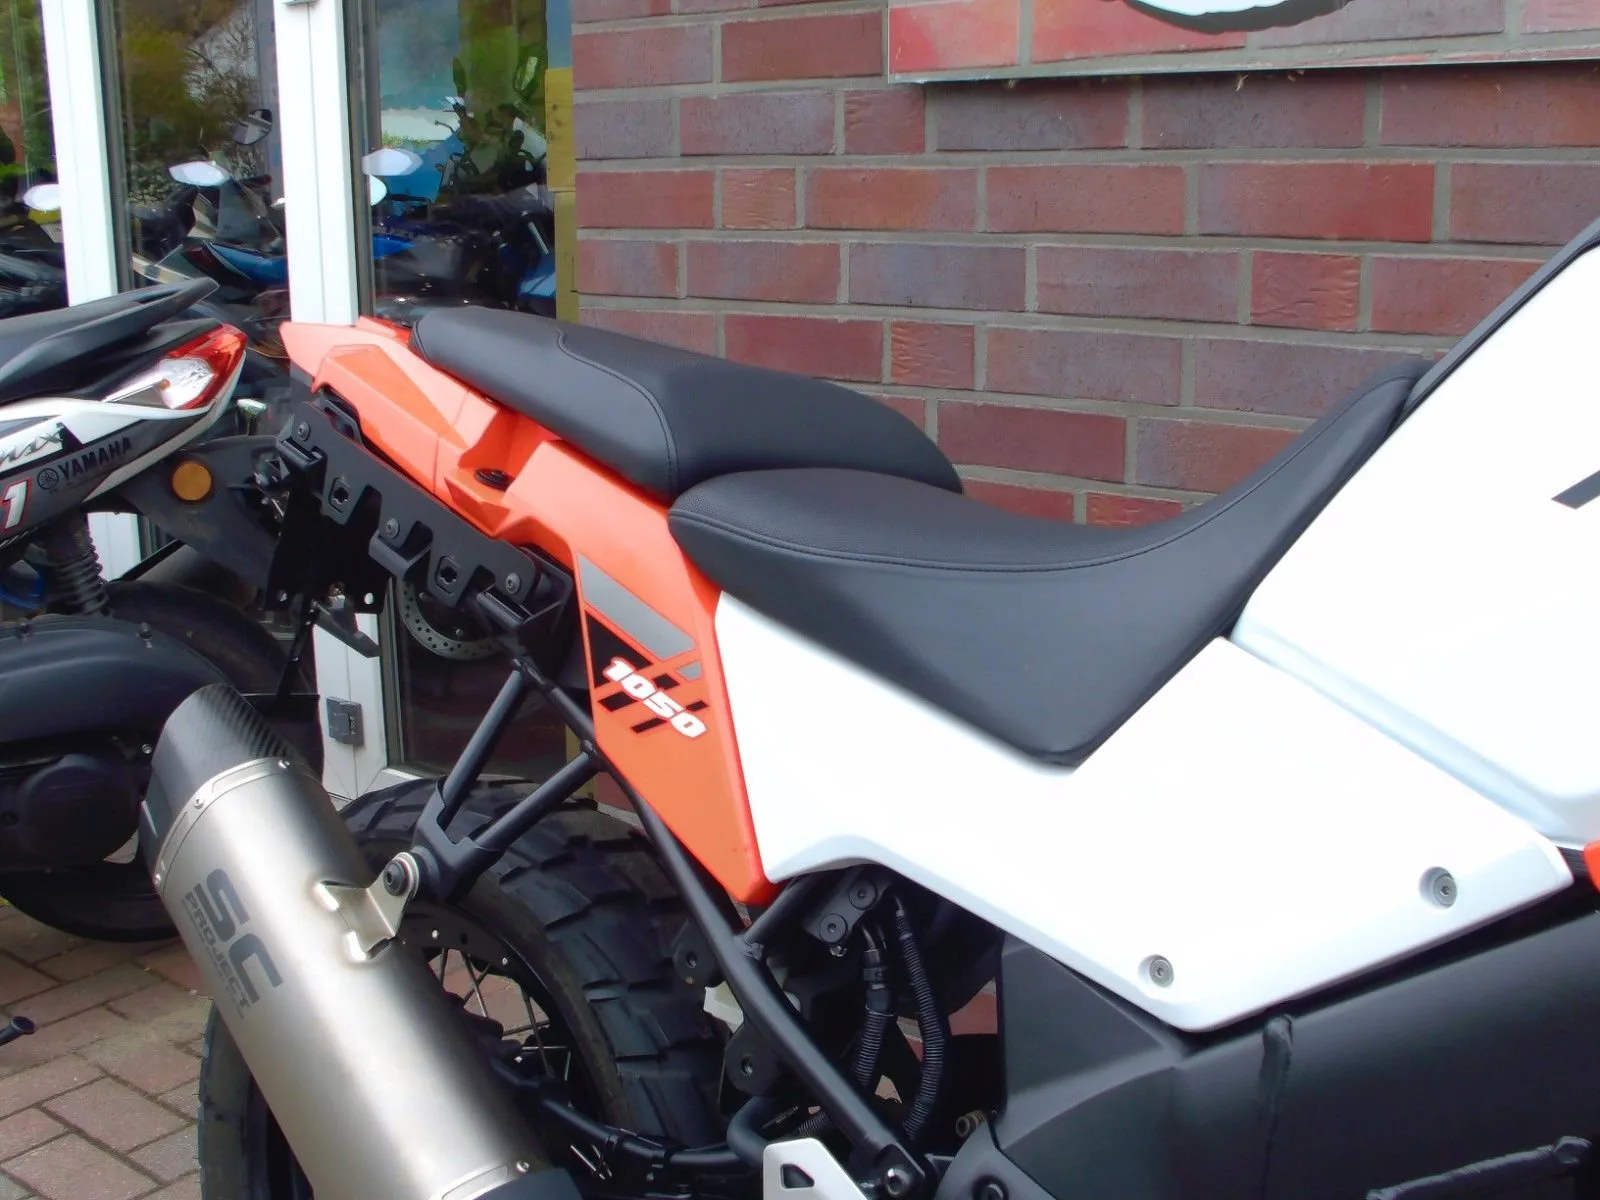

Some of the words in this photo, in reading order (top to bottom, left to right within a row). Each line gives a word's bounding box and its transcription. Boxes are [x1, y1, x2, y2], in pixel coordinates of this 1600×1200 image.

[58, 437, 132, 480] YAMAHA
[603, 657, 707, 738] 1050
[184, 889, 251, 1008] PROJECT
[193, 868, 283, 1003] SC
